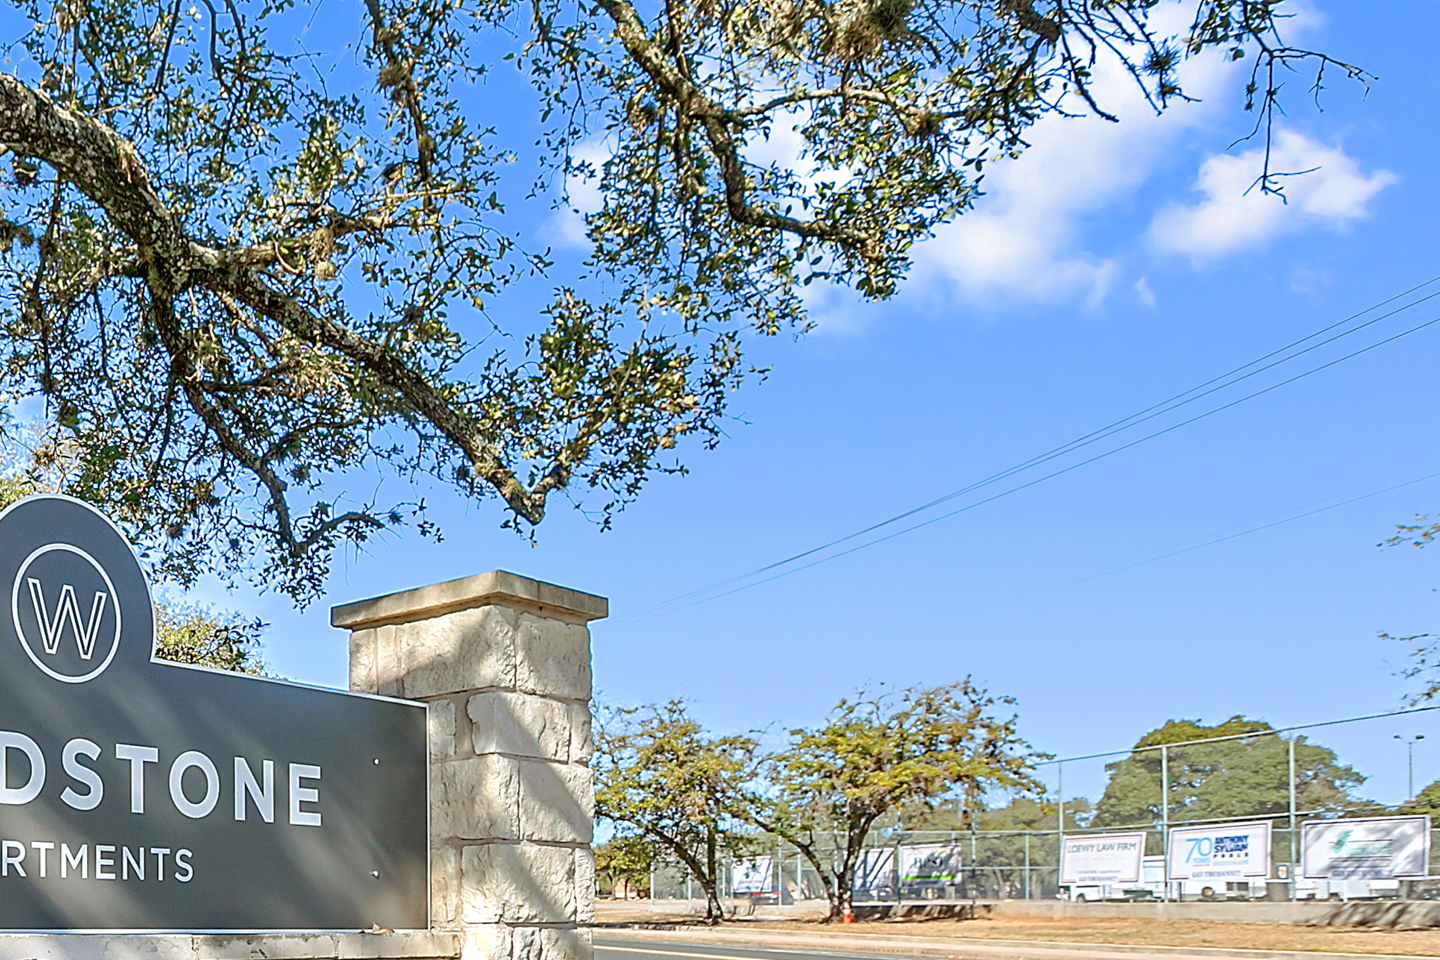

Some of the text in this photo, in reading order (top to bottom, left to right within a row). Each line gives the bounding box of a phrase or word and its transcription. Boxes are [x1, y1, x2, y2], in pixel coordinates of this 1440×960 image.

[27, 577, 108, 661] W
[1067, 842, 1137, 854] LOEWY LAW FIRM
[1185, 837, 1213, 864] 70
